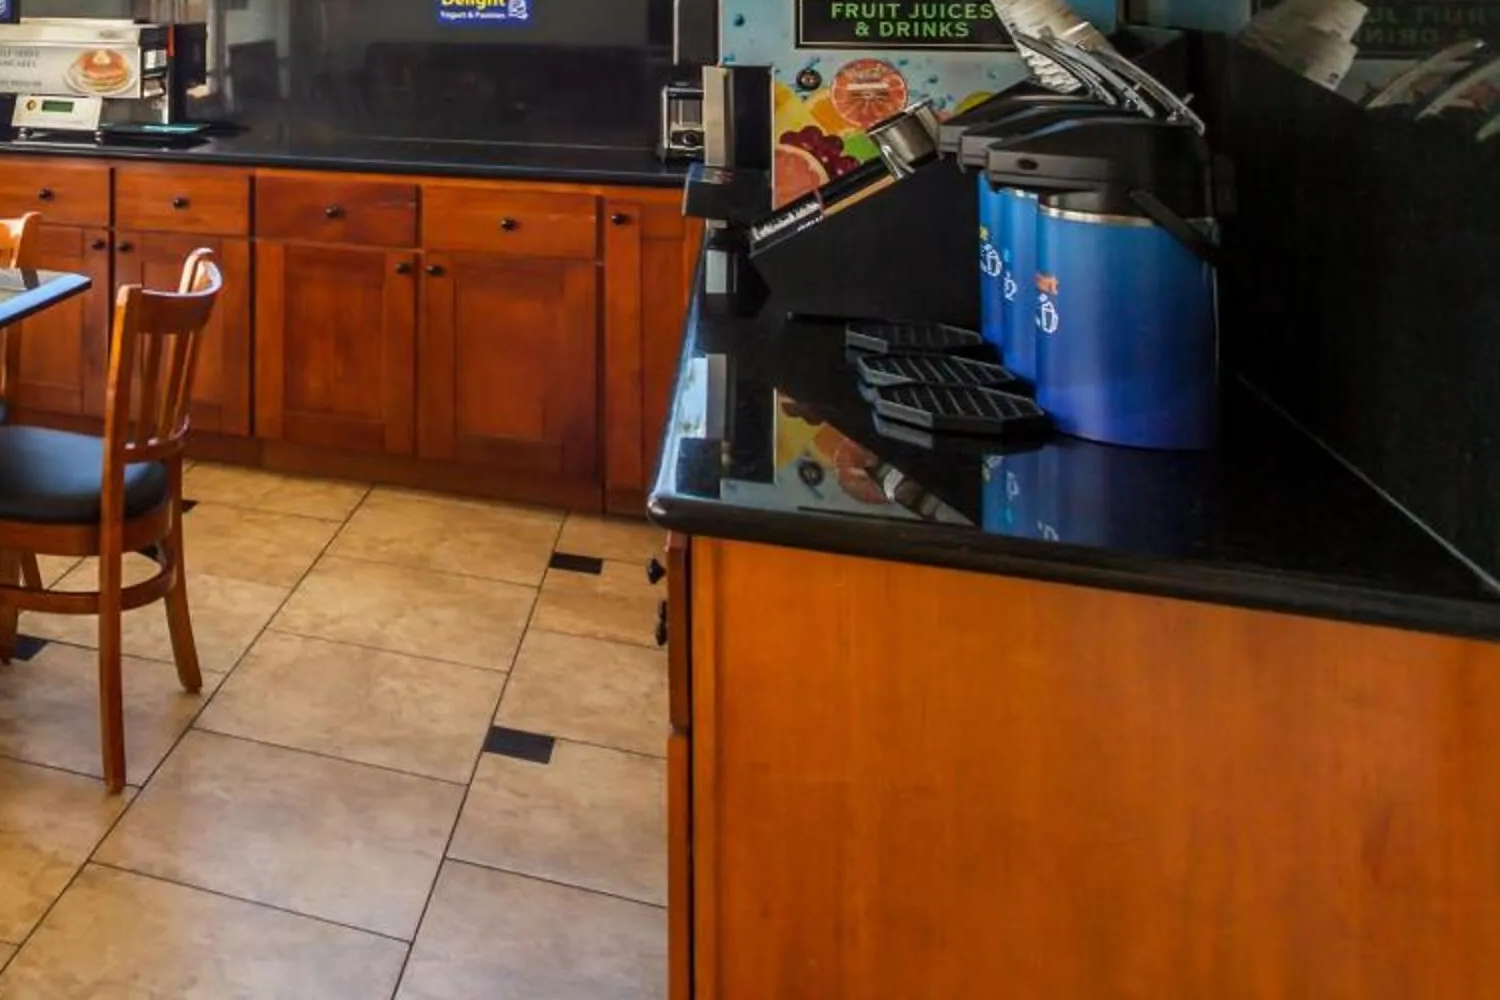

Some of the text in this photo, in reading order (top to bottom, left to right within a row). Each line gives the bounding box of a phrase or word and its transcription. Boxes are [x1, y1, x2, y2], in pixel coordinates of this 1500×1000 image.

[831, 2, 995, 19] FRUIT JUICES
[855, 21, 969, 37] & DRINKS
